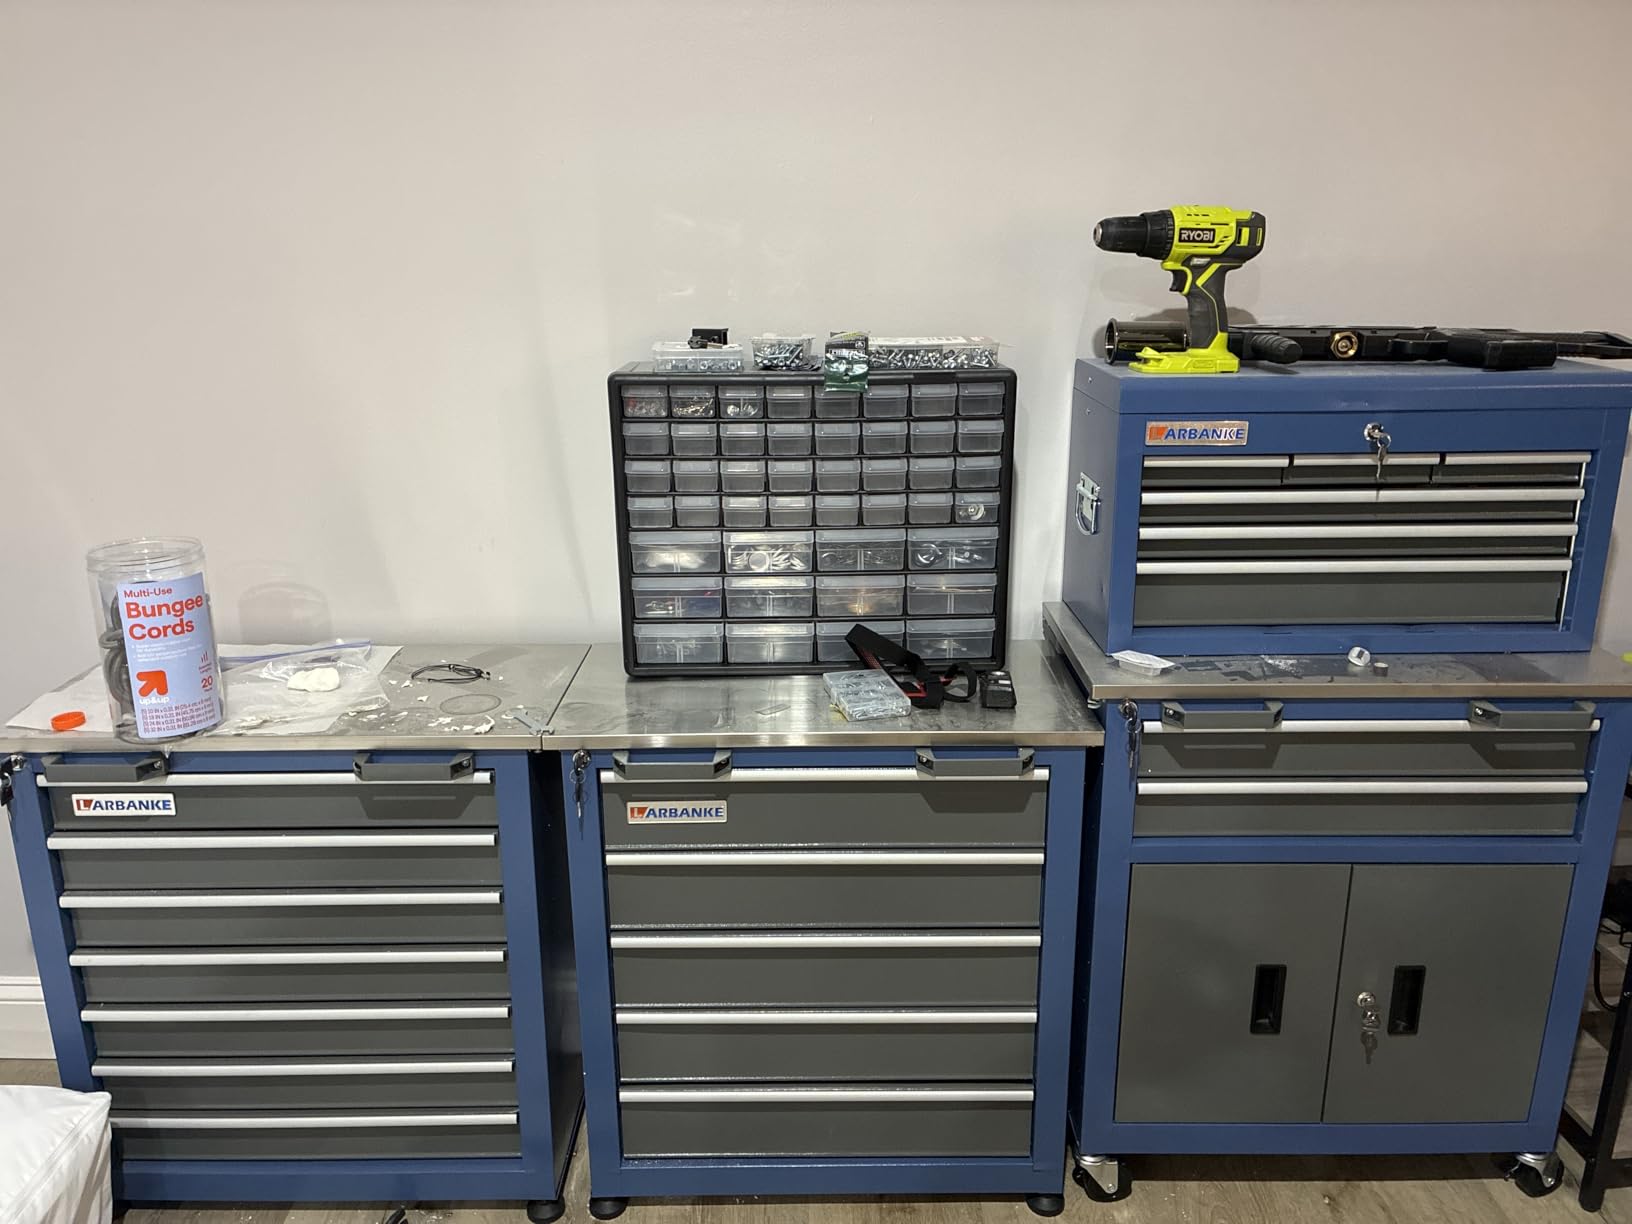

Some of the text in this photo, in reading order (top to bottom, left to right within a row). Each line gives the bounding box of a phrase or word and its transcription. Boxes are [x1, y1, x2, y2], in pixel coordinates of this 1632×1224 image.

[1180, 230, 1214, 241] RYOBI
[123, 588, 173, 598] Multi-Use
[125, 595, 203, 619] Bungee
[128, 618, 195, 640] Cords
[201, 675, 214, 689] 20
[139, 696, 169, 705] up&up
[76, 799, 172, 811] LARBANKE
[630, 806, 724, 818] LARBANKE
